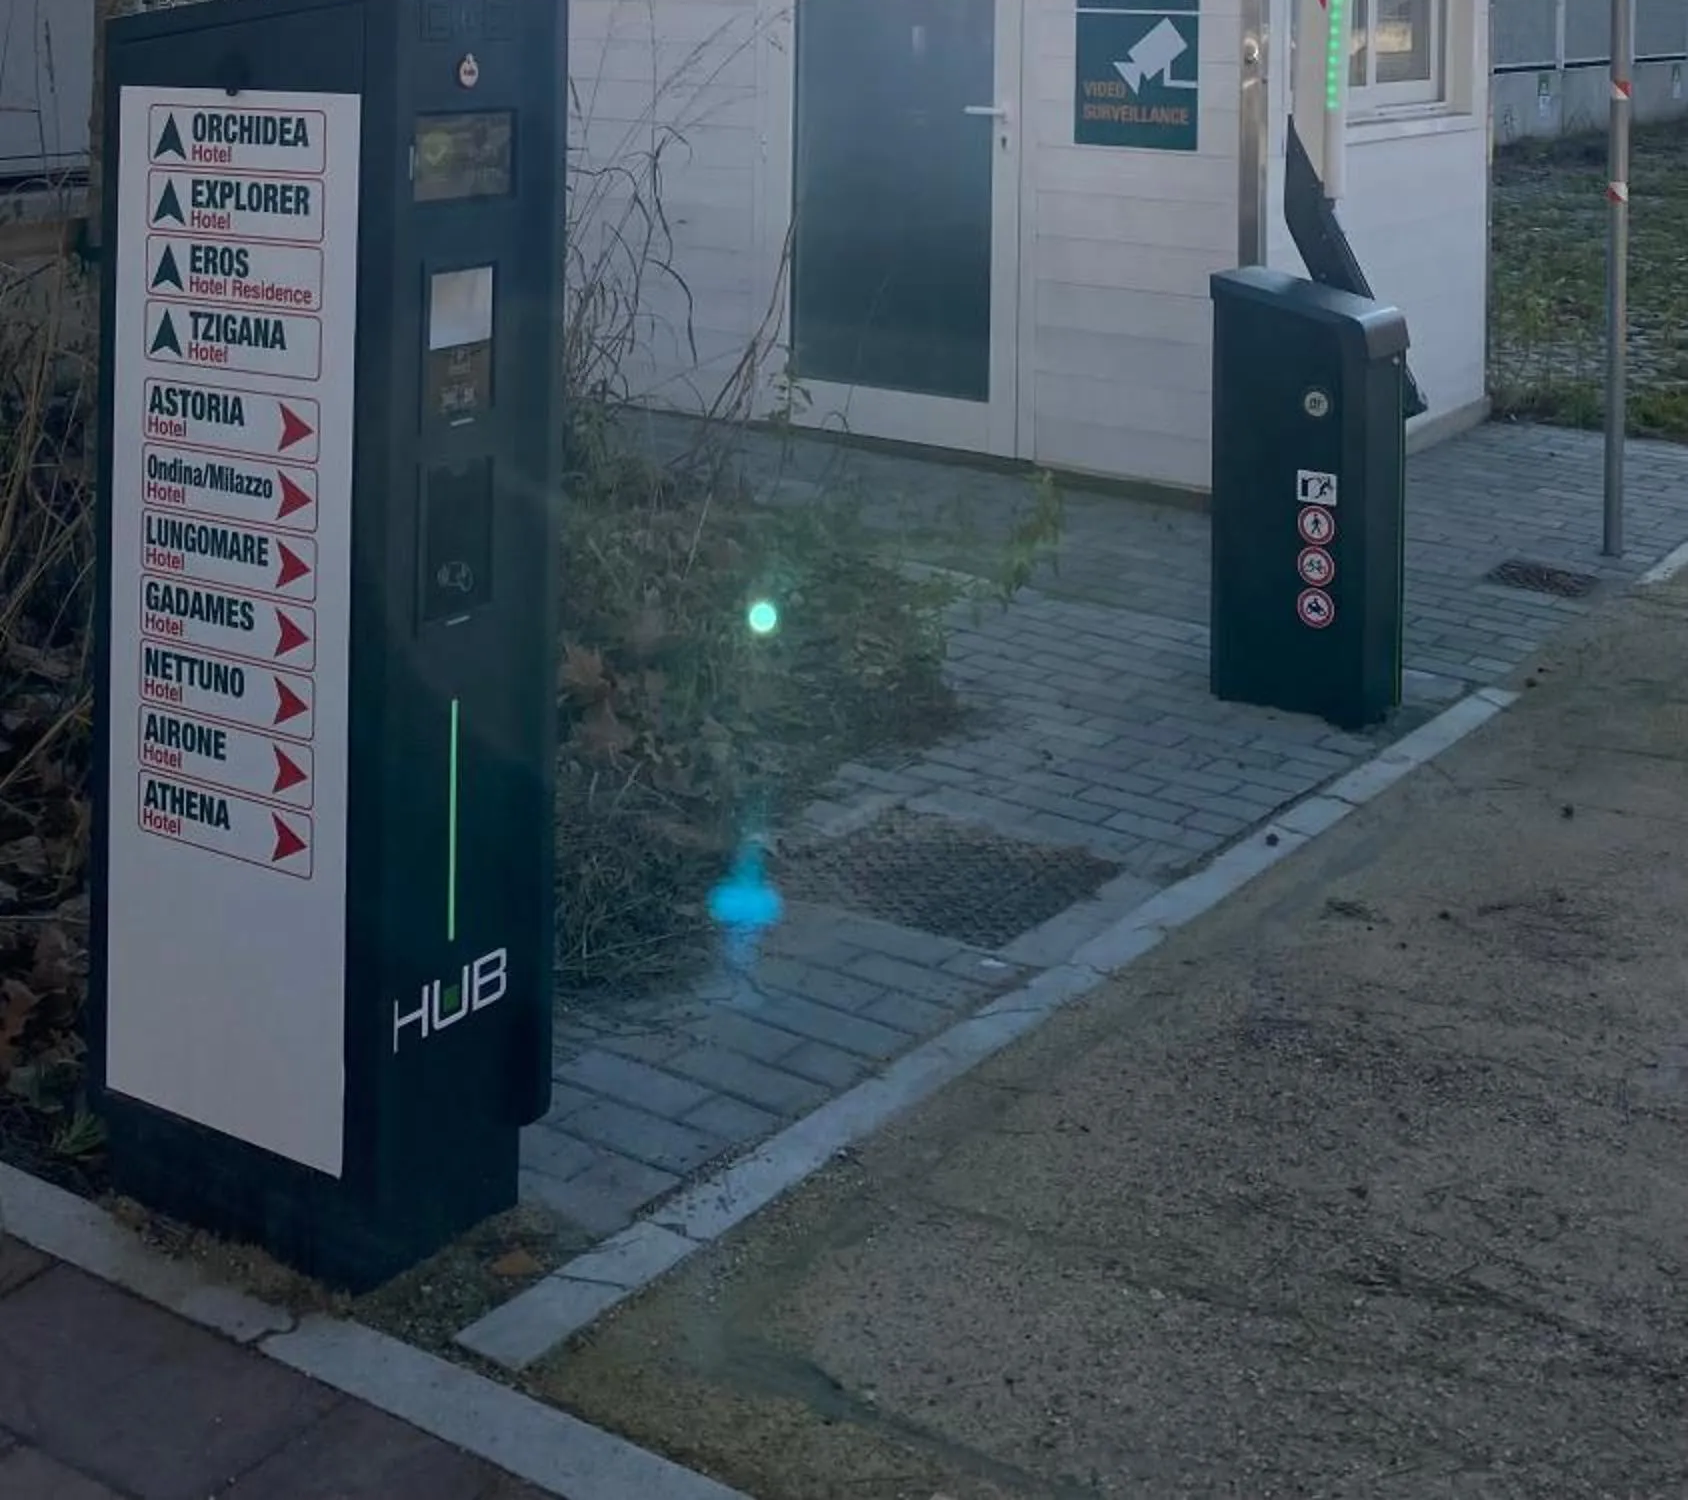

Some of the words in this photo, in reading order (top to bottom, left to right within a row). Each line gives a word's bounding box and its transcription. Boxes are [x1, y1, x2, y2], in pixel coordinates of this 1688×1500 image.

[1083, 81, 1126, 99] VIDEO
[1082, 103, 1190, 126] SURVEILLANCE
[191, 111, 310, 148] ORCHIDEA
[191, 145, 232, 164] Hotel
[190, 179, 310, 216] EXPLORER
[190, 211, 231, 230] Hotel
[190, 245, 249, 278] EROS
[189, 276, 228, 297] Hotel
[231, 280, 313, 305] Residence
[189, 311, 287, 350] TZIGANA
[187, 342, 229, 364] Hotel
[148, 385, 245, 427] ASTORIA
[147, 415, 187, 437] Hotel
[147, 454, 273, 499] Ondina/Milazzo
[146, 483, 186, 505] Hotel
[146, 515, 270, 567] LUNGOMARE
[145, 547, 185, 571] Hotel
[145, 581, 255, 631] GADAMES
[144, 612, 184, 636] Hotel
[144, 646, 245, 698] NETTUNO
[144, 678, 183, 703] Hotel
[144, 713, 227, 762] AIRONE
[143, 744, 182, 768] Hotel
[144, 778, 231, 831] ATHENA
[143, 808, 181, 836] Hotel
[393, 947, 507, 1054] HUB
